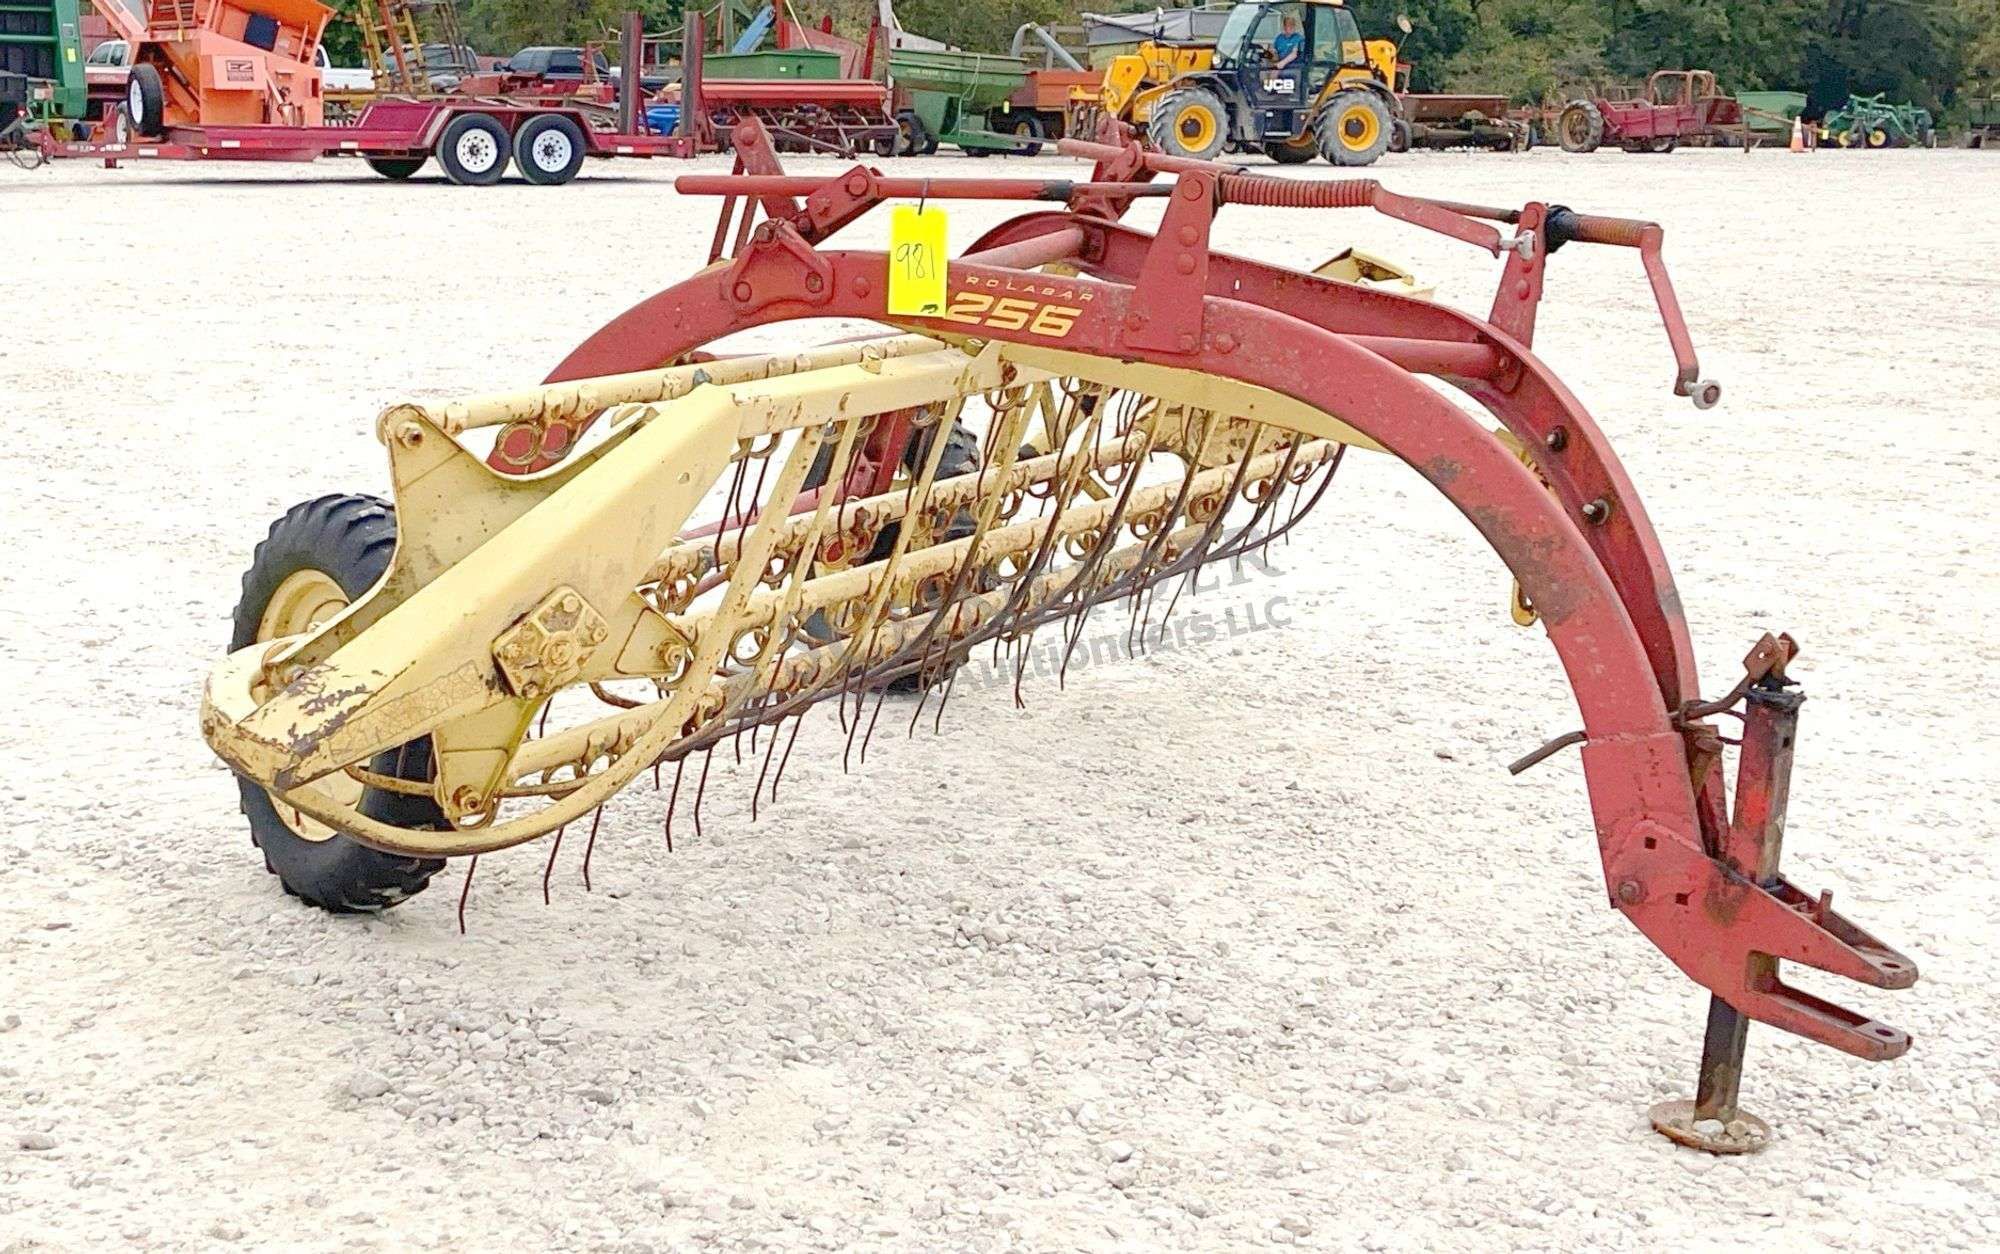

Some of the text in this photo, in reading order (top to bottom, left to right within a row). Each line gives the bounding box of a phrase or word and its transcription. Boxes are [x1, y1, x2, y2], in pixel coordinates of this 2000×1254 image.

[1263, 79, 1294, 92] JCB
[896, 243, 935, 280] 981
[965, 276, 1095, 301] ROLABAR
[944, 291, 1083, 338] 256
